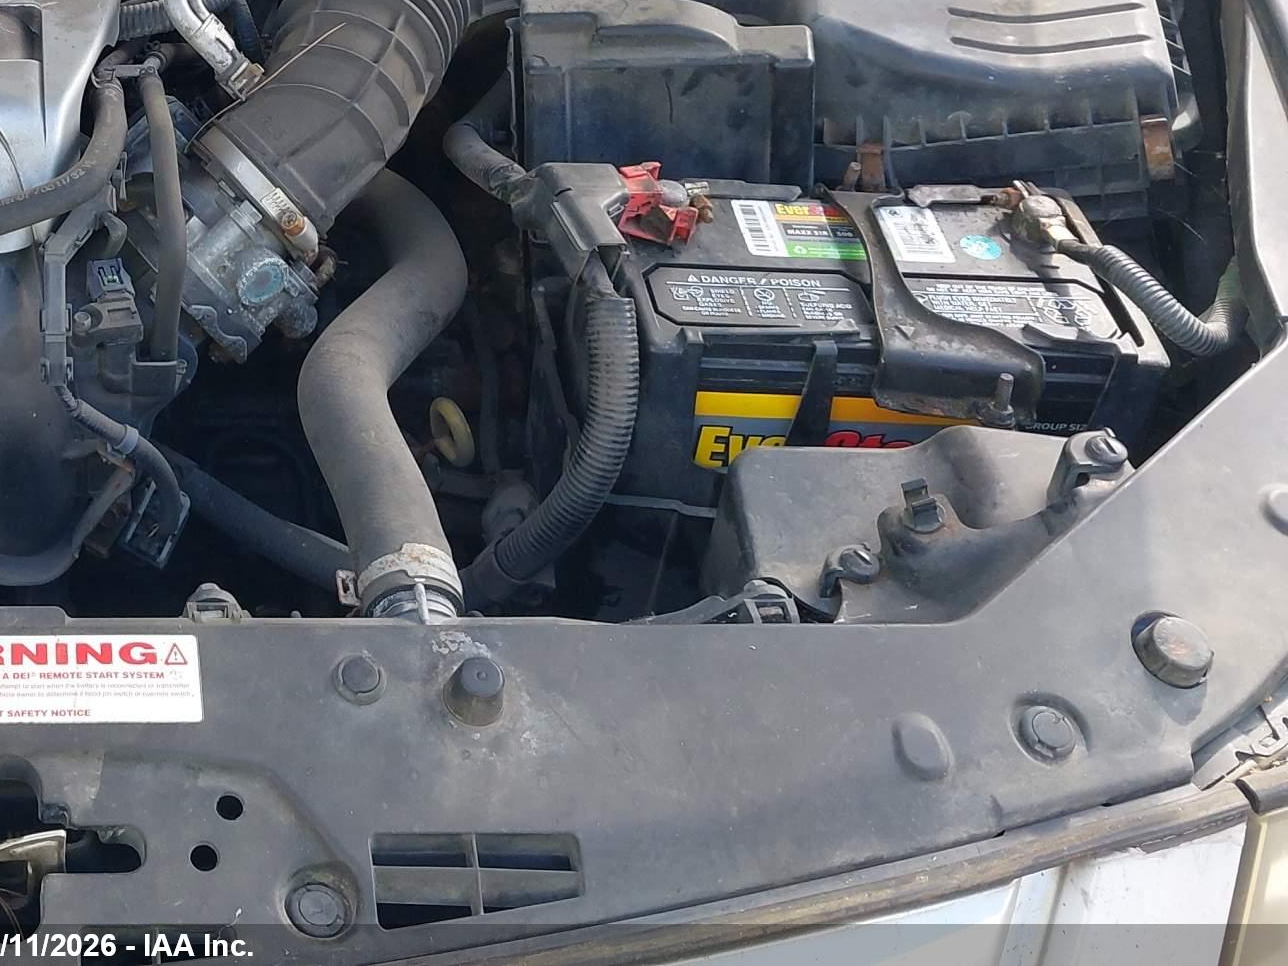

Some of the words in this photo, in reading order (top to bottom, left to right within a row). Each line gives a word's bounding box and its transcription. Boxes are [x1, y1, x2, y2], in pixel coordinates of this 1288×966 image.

[700, 274, 757, 285] DANGER
[770, 278, 822, 287] POISON
[1025, 422, 1068, 431] ROUP
[2, 672, 9, 680] A
[39, 671, 83, 679] REMOTE
[85, 671, 119, 679] START
[122, 671, 165, 679] SYSTEM
[7, 709, 48, 718] SAFETY
[50, 709, 91, 717] NOTICE
